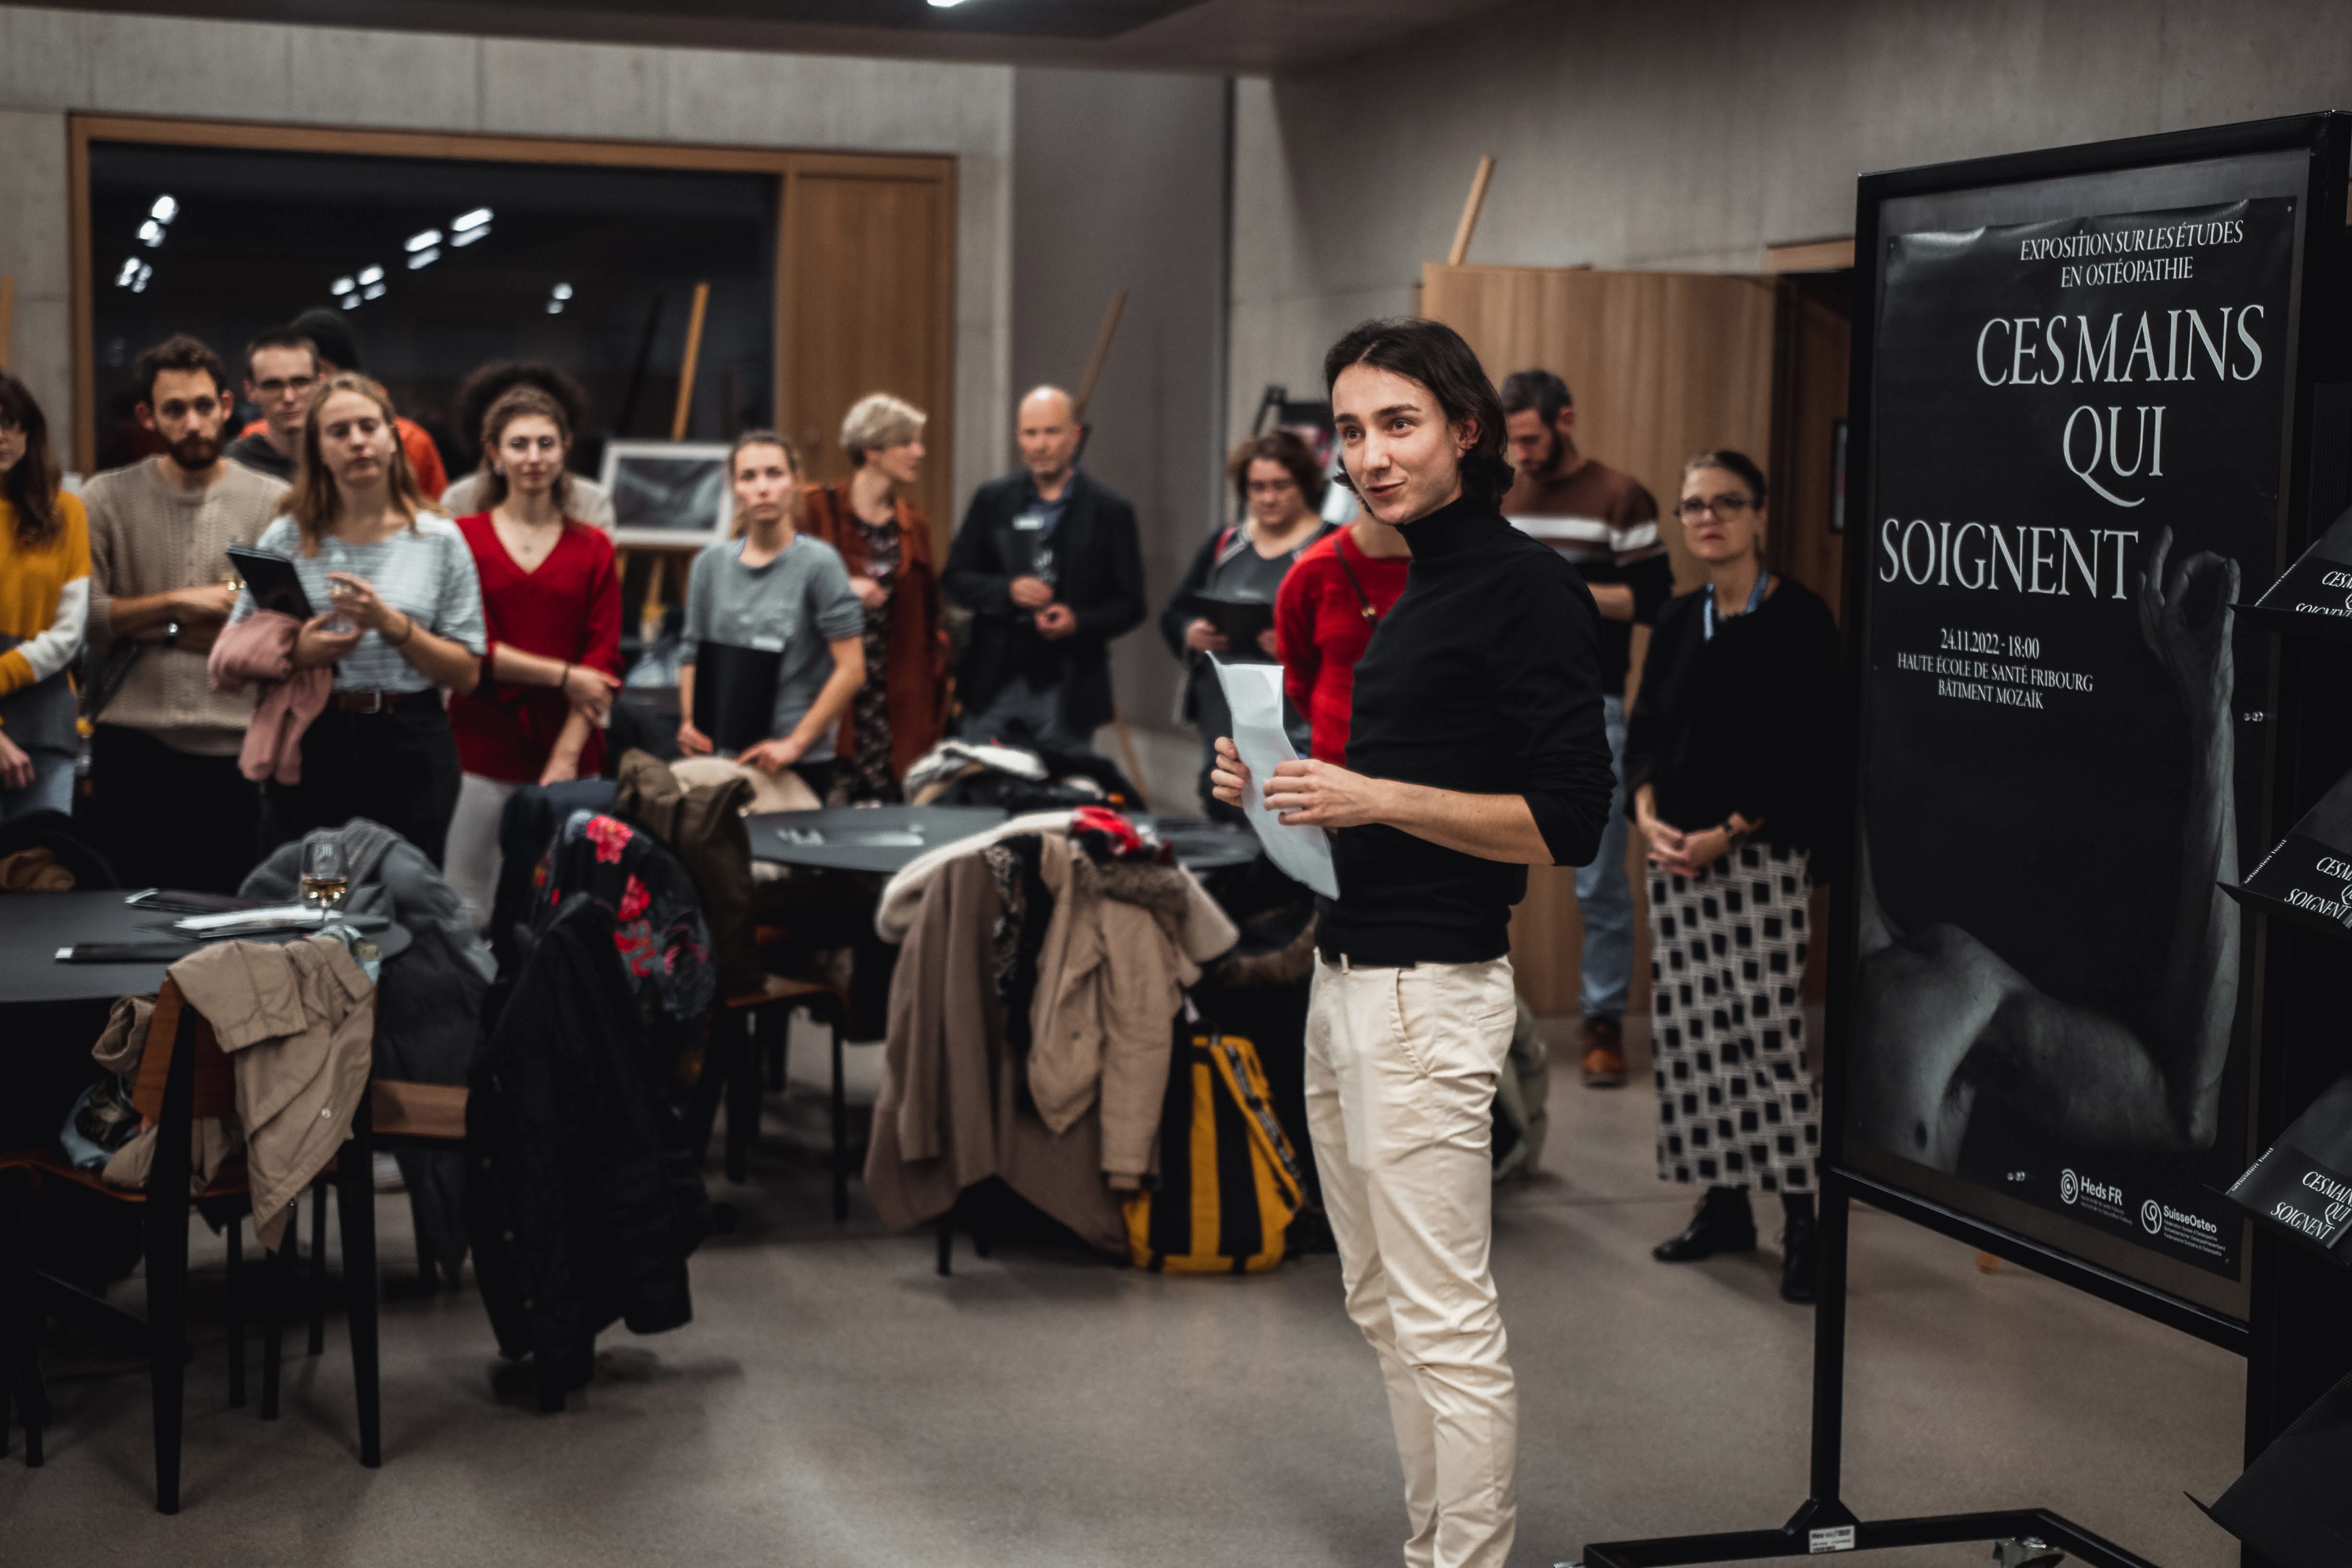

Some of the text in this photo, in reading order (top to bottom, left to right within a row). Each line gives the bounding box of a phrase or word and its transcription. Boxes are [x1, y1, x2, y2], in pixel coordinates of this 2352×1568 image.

[2020, 219, 2243, 261] EXPOSITION SUR LES ÉTUDES
[2061, 256, 2193, 288] EN OSTÉOPATHIE
[1976, 304, 2264, 387] CES MAINS
[2062, 405, 2167, 508] QUI
[1879, 518, 2139, 600] SOIGNENT
[1940, 628, 2000, 655] 24.11.2022
[2009, 635, 2039, 659] 18:00
[1897, 652, 2093, 692] HAUTE ÉCOLE DE SANTÉ FRIBOURG
[1996, 686, 2044, 709] MOZAÏK
[2284, 889, 2352, 919] SOIGNENT
[2081, 1176, 2107, 1200] Heds
[2108, 1186, 2122, 1206] FR
[2322, 1181, 2352, 1207] MAIN
[2163, 1205, 2217, 1233] SuisseOsteo
[2270, 1202, 2335, 1240] SOIGNENT
[2325, 1202, 2352, 1225] QUI
